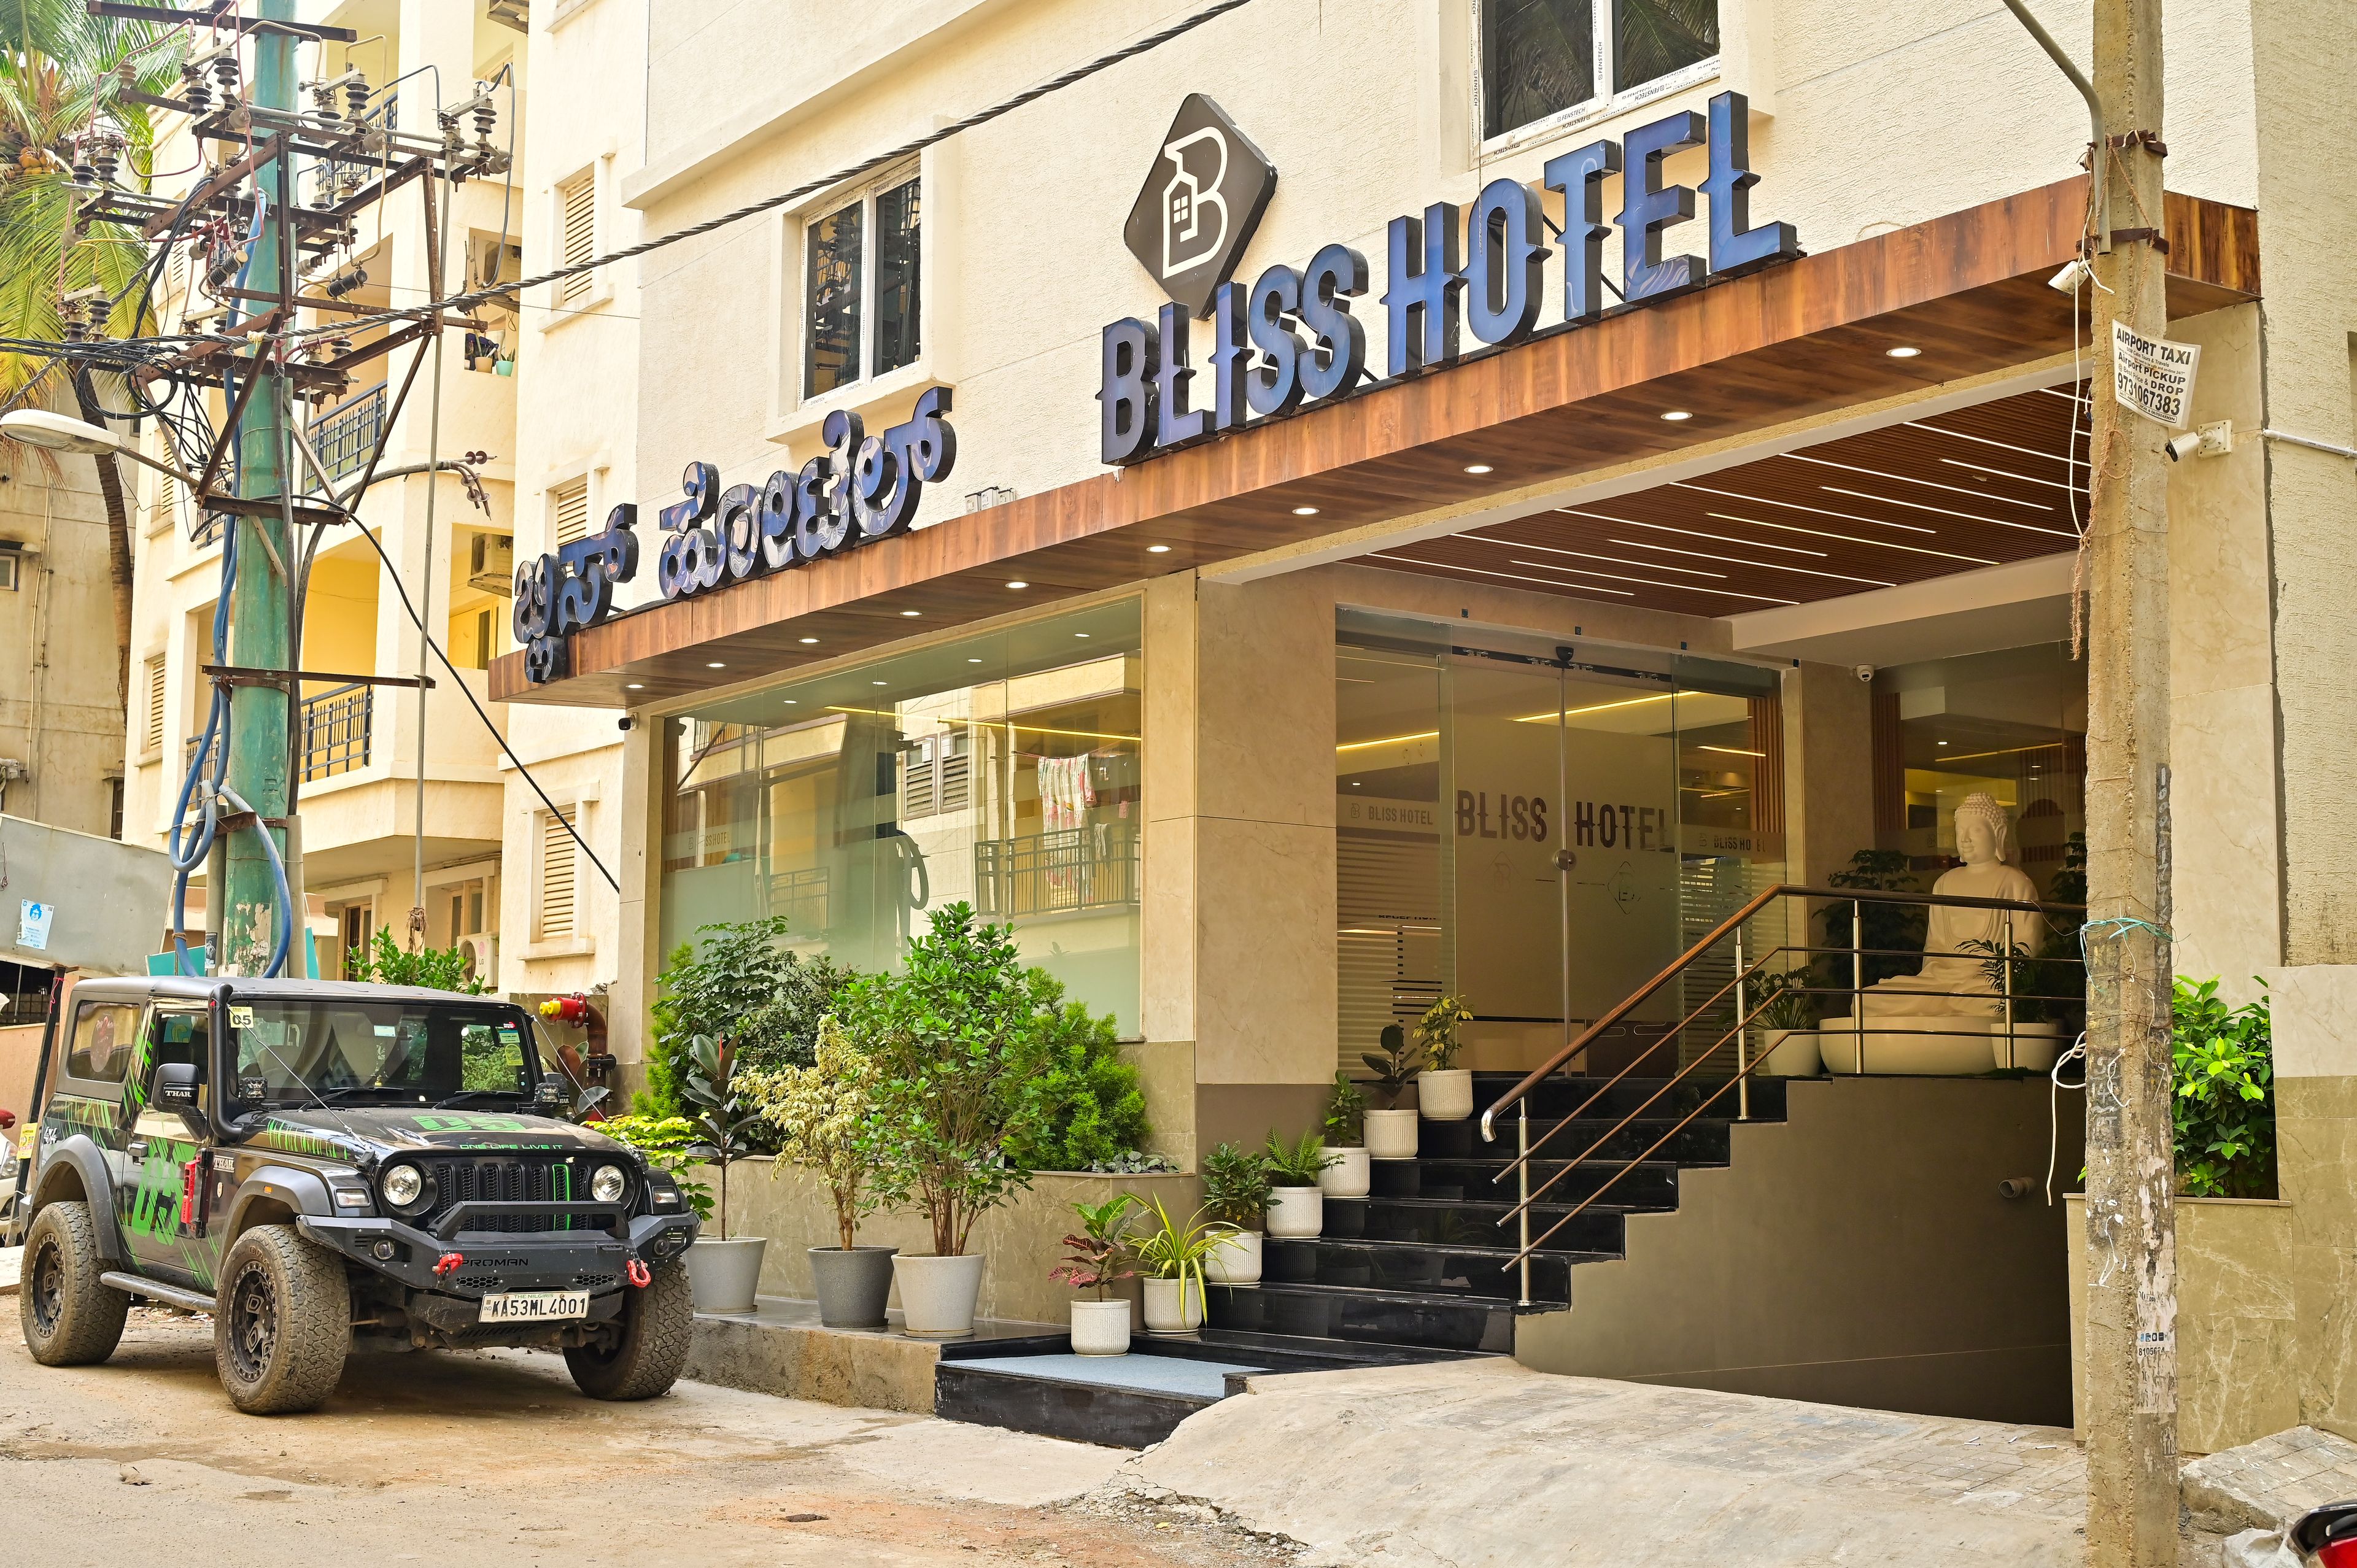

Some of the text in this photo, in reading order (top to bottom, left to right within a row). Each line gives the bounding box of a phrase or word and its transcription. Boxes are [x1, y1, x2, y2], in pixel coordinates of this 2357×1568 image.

[1635, 87, 1660, 101] FENSTECH
[1562, 107, 1586, 121] FENSTECH
[1562, 115, 1586, 129] FENSTECH
[1095, 90, 1798, 466] BLISS HOTEL
[2116, 328, 2156, 356] AIRPORT
[2161, 346, 2191, 365] TAXI
[2118, 352, 2142, 374] Airport
[2144, 366, 2186, 385] PICKUP
[2118, 363, 2123, 372] @
[2124, 366, 2133, 376] Best
[2133, 372, 2143, 383] Price
[2151, 380, 2184, 395] DROP
[2118, 373, 2181, 415] 9731067383
[2151, 410, 2175, 421] OUTSTATION
[1369, 806, 1398, 822] BLISS
[1399, 809, 1433, 825] HOTEL
[1455, 789, 1675, 853] BLISS HOTEL
[1714, 835, 1766, 852] BLISS HOEL
[233, 1014, 251, 1025] 05
[411, 1115, 526, 1131] 05
[214, 1159, 235, 1170] THAR
[462, 1258, 528, 1267] PROMAN
[491, 1298, 586, 1317] KA53ML4001
